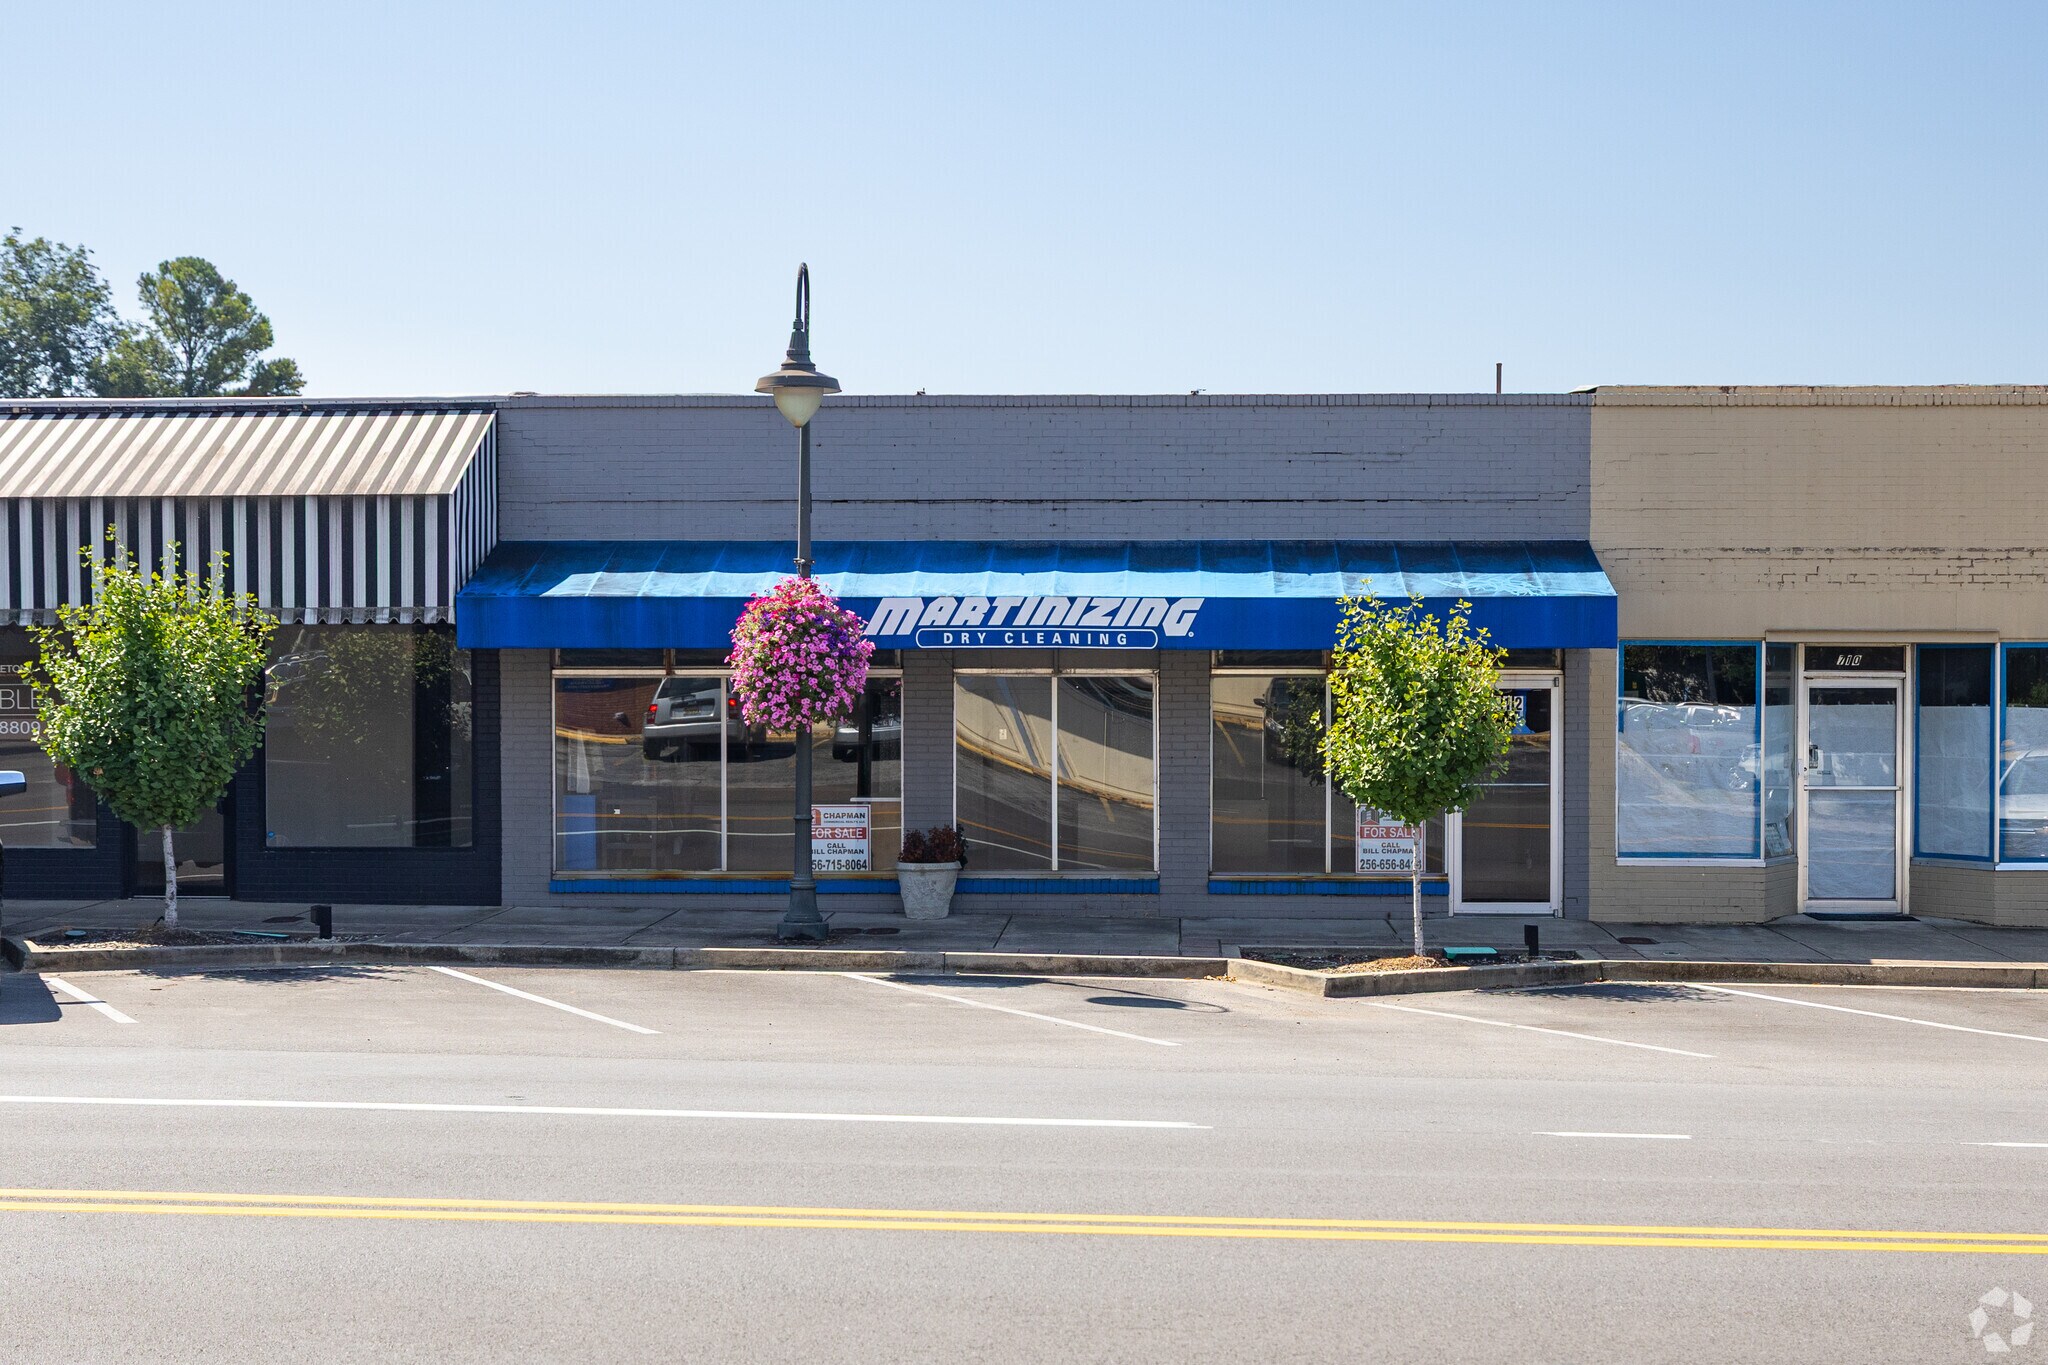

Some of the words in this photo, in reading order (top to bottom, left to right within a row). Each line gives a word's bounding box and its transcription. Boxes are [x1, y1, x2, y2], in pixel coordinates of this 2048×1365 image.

[864, 597, 1205, 637] MARTINIZING
[943, 632, 987, 645] DRY
[1004, 632, 1128, 645] CLEANING
[1836, 654, 1863, 666] 710
[834, 828, 863, 838] SALE
[1364, 827, 1387, 838] FOR
[811, 859, 867, 870] 56-715-8064
